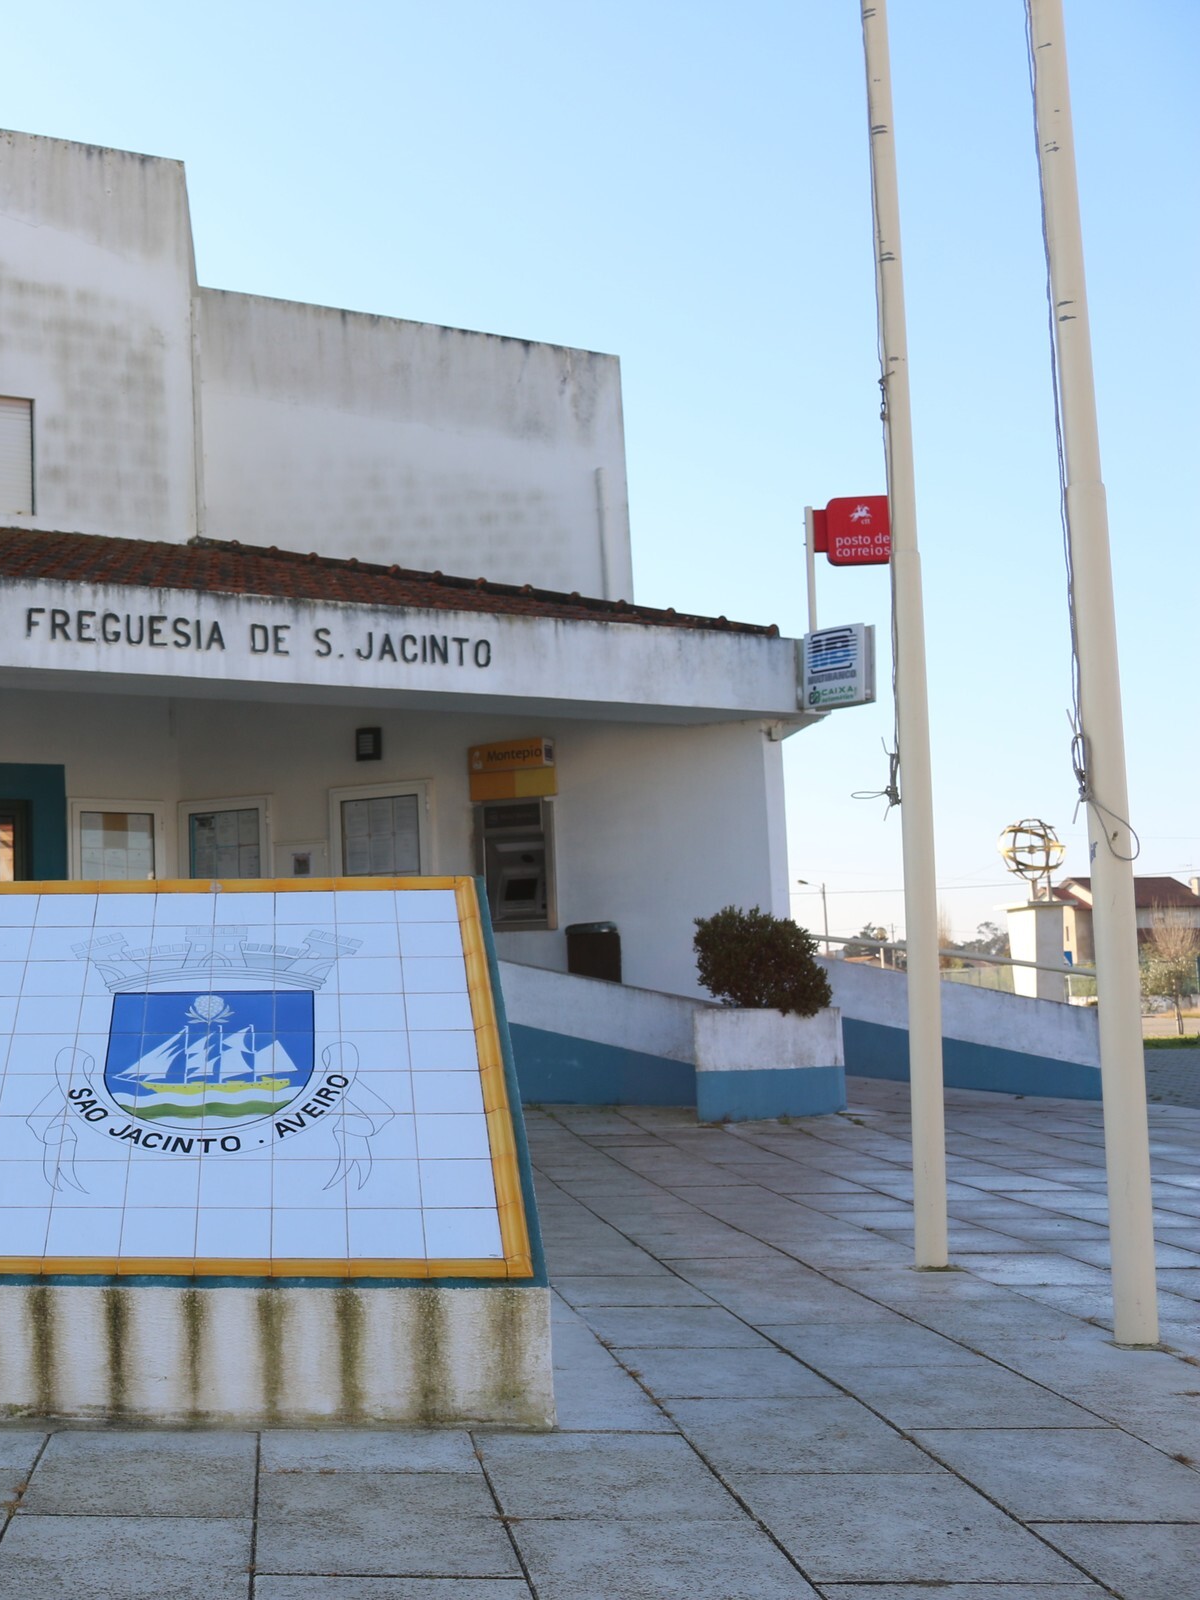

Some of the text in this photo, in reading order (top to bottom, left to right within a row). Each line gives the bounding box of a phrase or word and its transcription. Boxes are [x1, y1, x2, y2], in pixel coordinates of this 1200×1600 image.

[835, 532, 890, 548] posto de
[836, 544, 891, 557] correios
[26, 608, 226, 651] FREGUESIA
[250, 623, 291, 656] DE
[314, 628, 345, 658] S.
[355, 631, 492, 668] JACINTO
[821, 685, 854, 696] CAIXA
[487, 747, 542, 762] Montepio
[68, 1074, 350, 1153] SAO JACINTO AVEIRO
